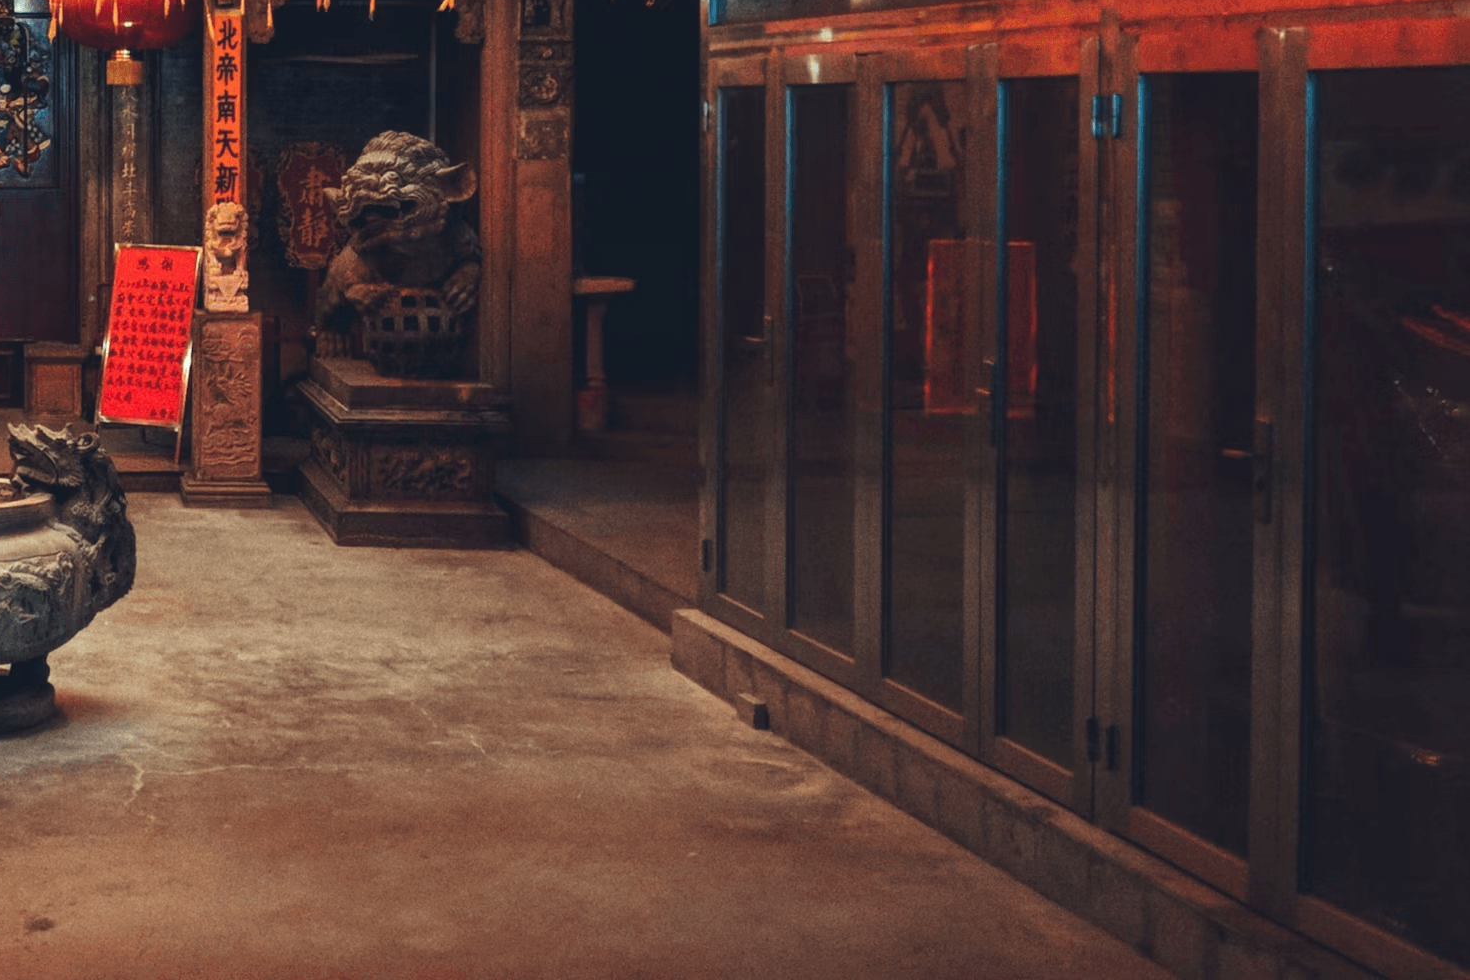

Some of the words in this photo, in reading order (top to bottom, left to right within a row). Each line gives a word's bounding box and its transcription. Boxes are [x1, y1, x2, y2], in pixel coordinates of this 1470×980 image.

[215, 20, 239, 208] 北帝南天新
